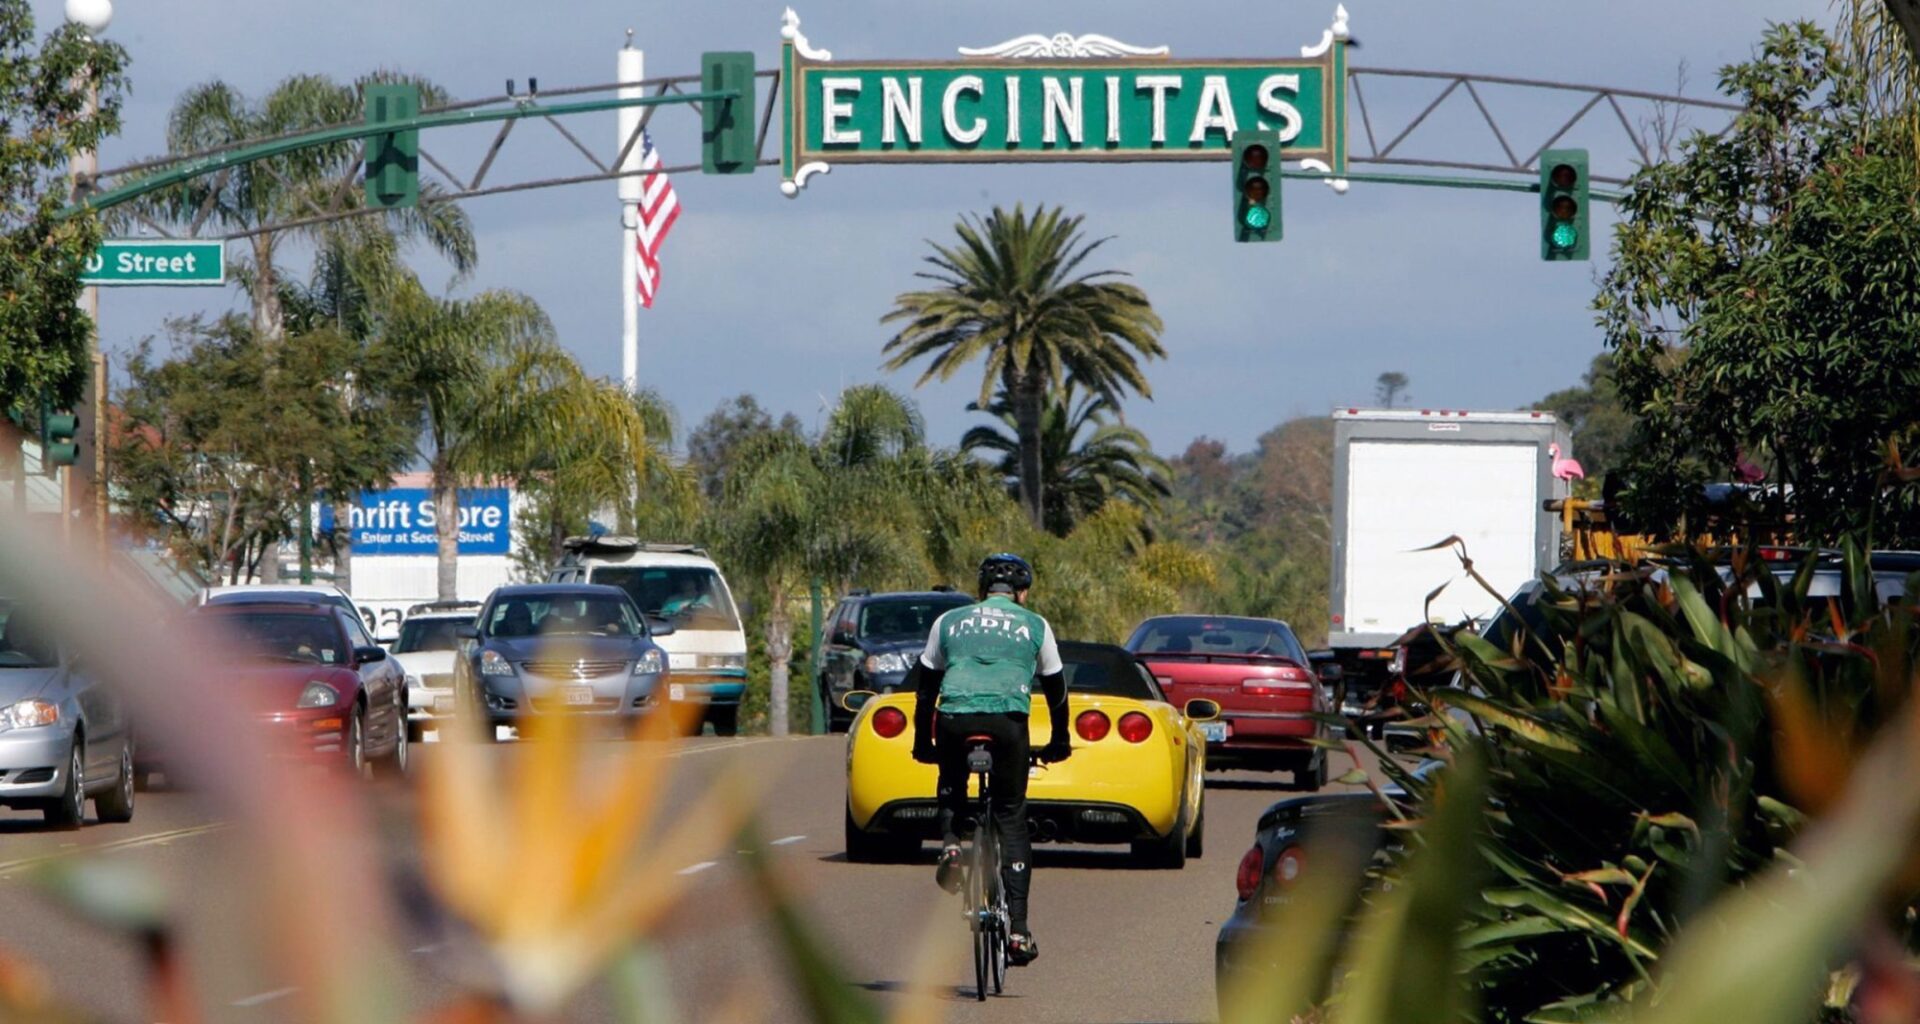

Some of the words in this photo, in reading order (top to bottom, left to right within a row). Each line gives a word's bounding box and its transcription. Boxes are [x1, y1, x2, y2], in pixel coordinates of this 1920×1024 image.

[821, 74, 1303, 144] ENCINITAS
[116, 251, 196, 273] Street
[350, 500, 411, 529] hrift
[417, 500, 502, 528] Sore
[361, 531, 392, 544] Enter
[395, 531, 409, 544] at
[458, 531, 495, 543] Street
[949, 617, 1030, 640] INDIA
